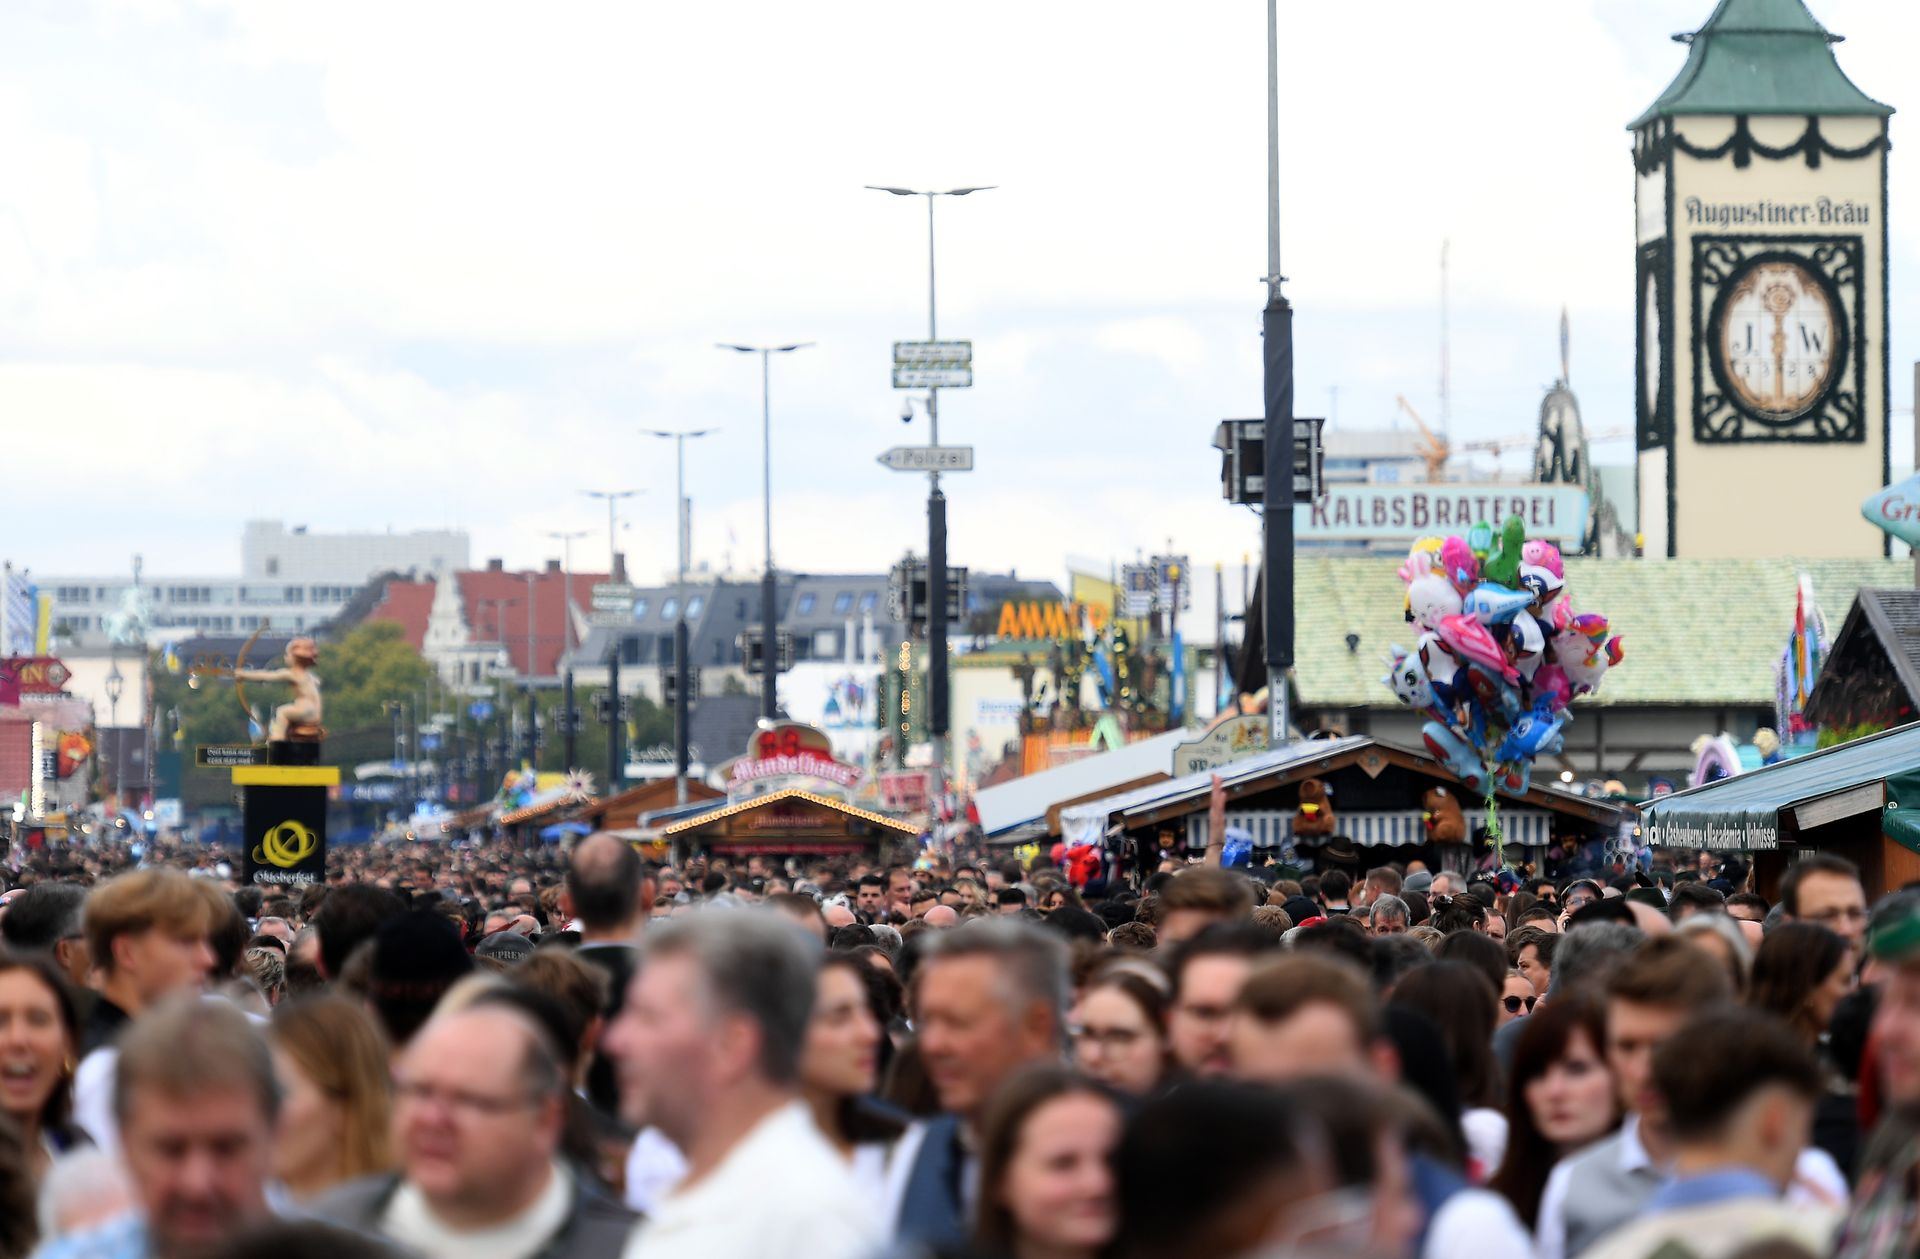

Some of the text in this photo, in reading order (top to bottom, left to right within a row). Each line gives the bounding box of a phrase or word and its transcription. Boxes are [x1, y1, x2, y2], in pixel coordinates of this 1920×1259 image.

[1686, 196, 1870, 230] Augustiner-Bräu
[903, 447, 966, 465] Polizei
[1666, 820, 1703, 848] Cashewkerne
[1707, 821, 1742, 849] Macadamia
[253, 871, 316, 884] Oktoberfest
